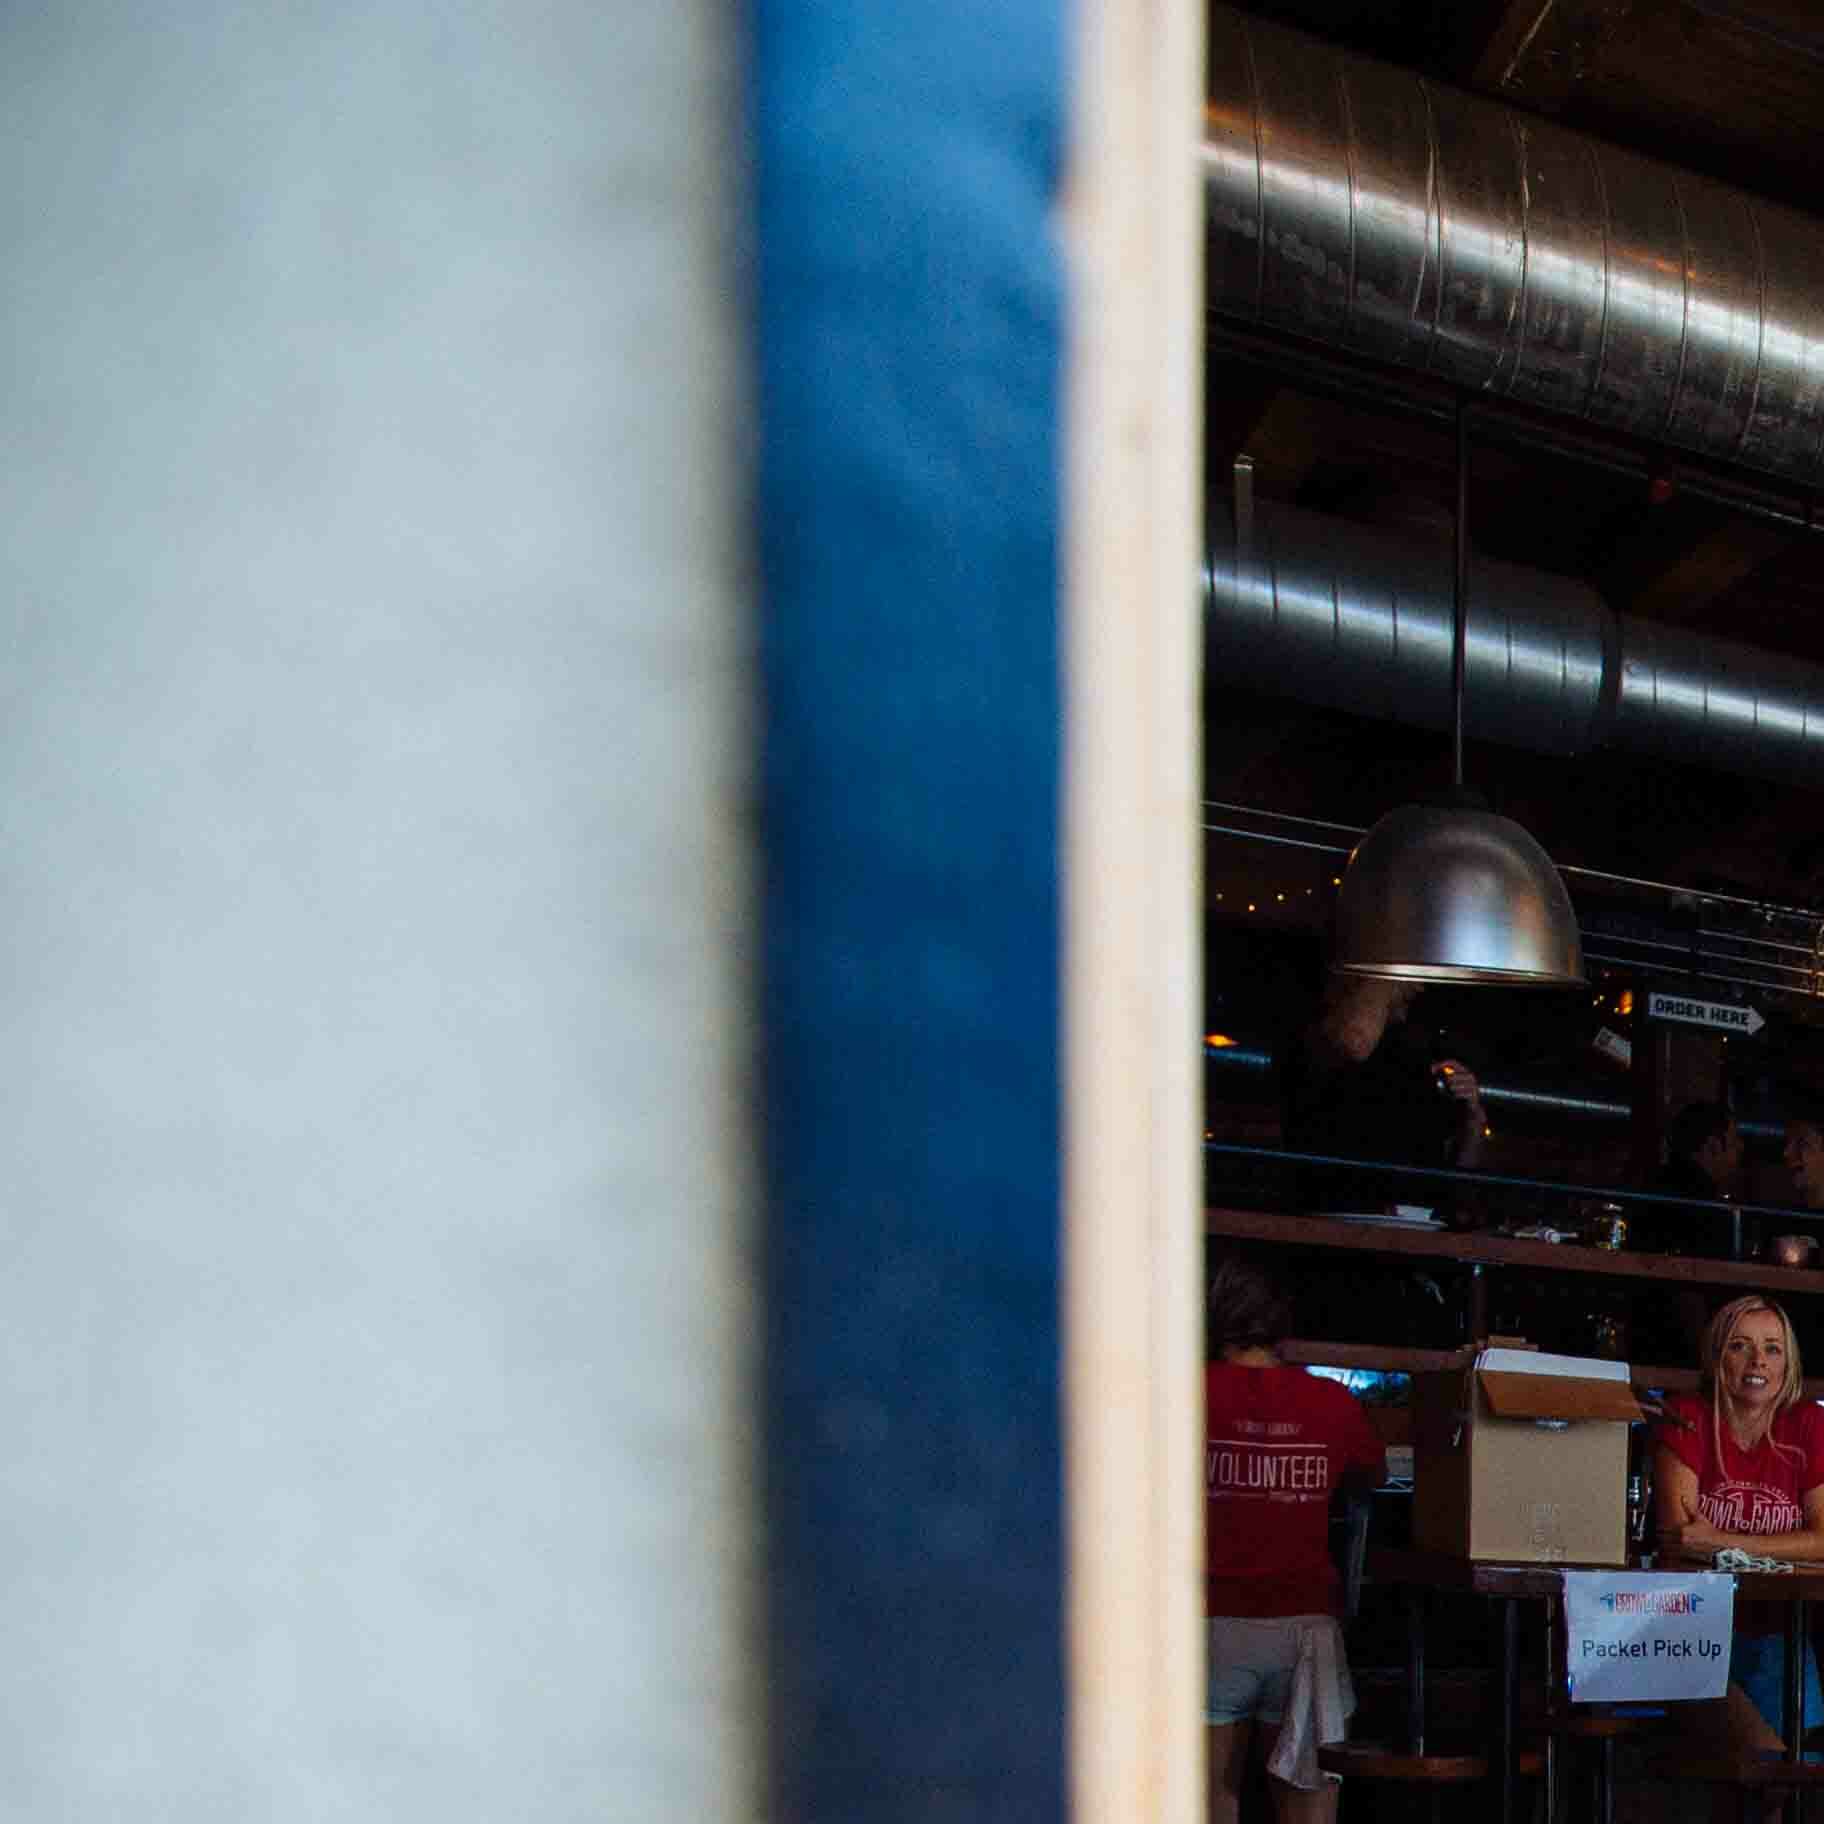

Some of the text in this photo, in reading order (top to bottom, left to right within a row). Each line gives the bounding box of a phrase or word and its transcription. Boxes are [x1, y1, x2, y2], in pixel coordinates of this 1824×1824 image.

[1655, 998, 1746, 1027] ORDER HERE
[1207, 1451, 1329, 1489] VOLUNTEER
[1582, 1639, 1721, 1661] Packet Pick Up
